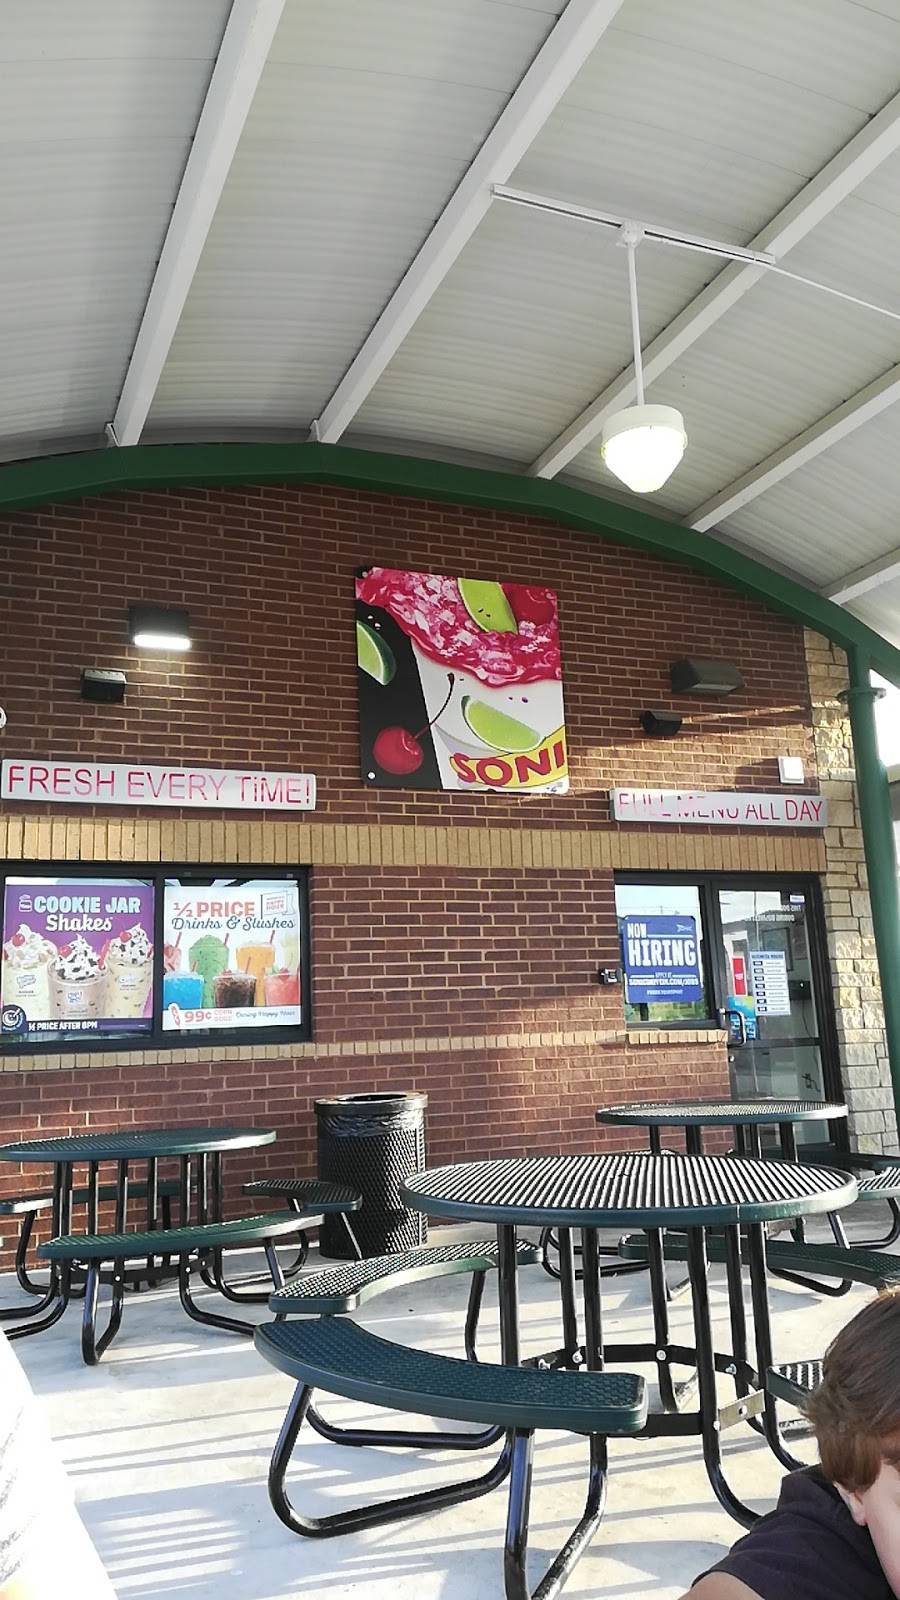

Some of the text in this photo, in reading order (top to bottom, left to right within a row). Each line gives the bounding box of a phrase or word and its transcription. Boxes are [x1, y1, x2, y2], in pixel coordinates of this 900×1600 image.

[8, 765, 116, 797] FRESH
[128, 770, 228, 802] EVERY
[746, 803, 780, 820] ALL
[785, 799, 823, 821] DAY
[34, 895, 141, 914] COOKIE JAR
[196, 901, 255, 918] PRICE
[46, 914, 111, 932] Shakes
[172, 916, 296, 931] Drinks & Slushes
[627, 922, 647, 937] NOW
[628, 939, 697, 967] HIRING
[37, 1021, 58, 1031] PRICE
[59, 1021, 81, 1030] AFTER
